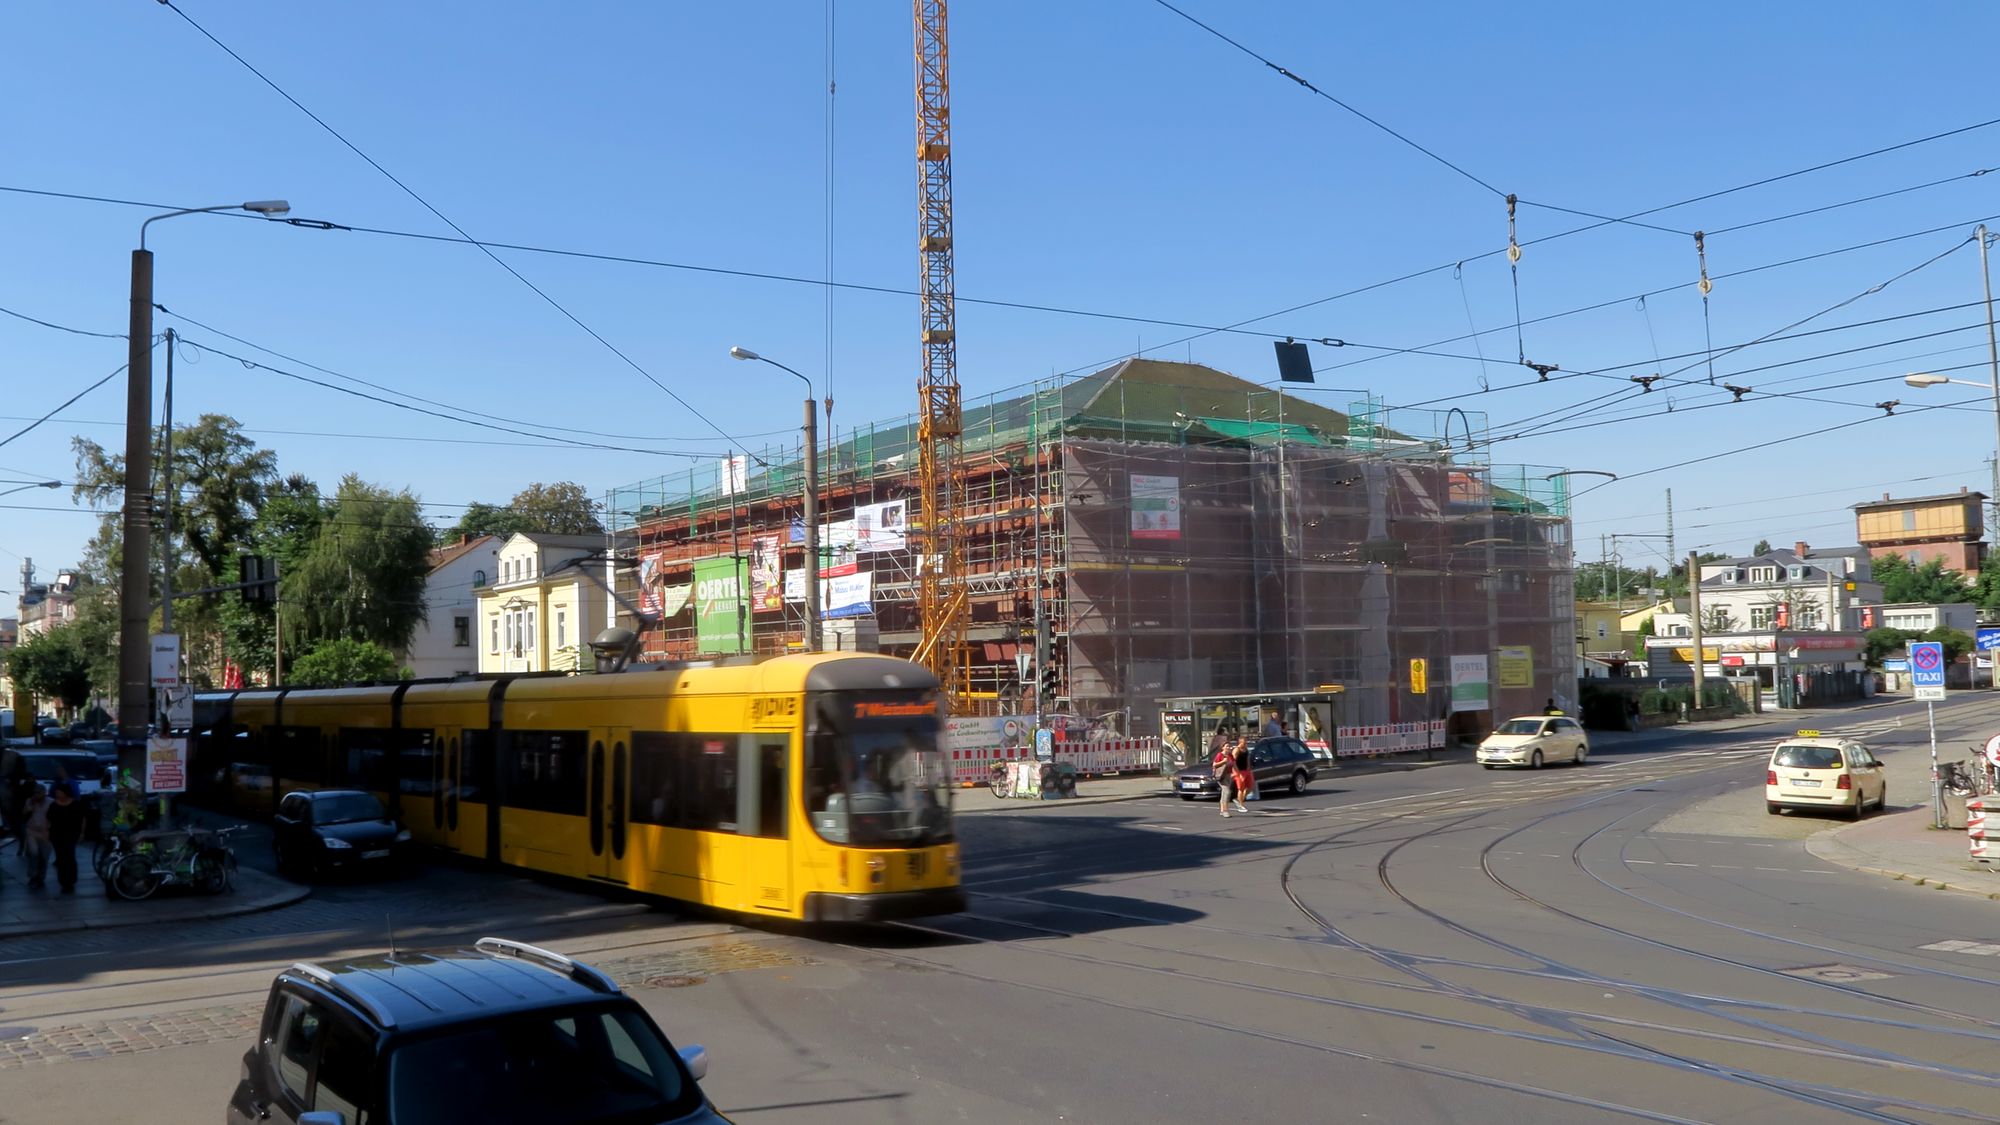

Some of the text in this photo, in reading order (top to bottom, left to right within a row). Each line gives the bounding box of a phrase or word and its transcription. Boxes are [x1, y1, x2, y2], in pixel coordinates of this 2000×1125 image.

[698, 576, 745, 600] OERTEL
[1454, 661, 1485, 672] OERTEL
[1916, 672, 1940, 682] TAXI
